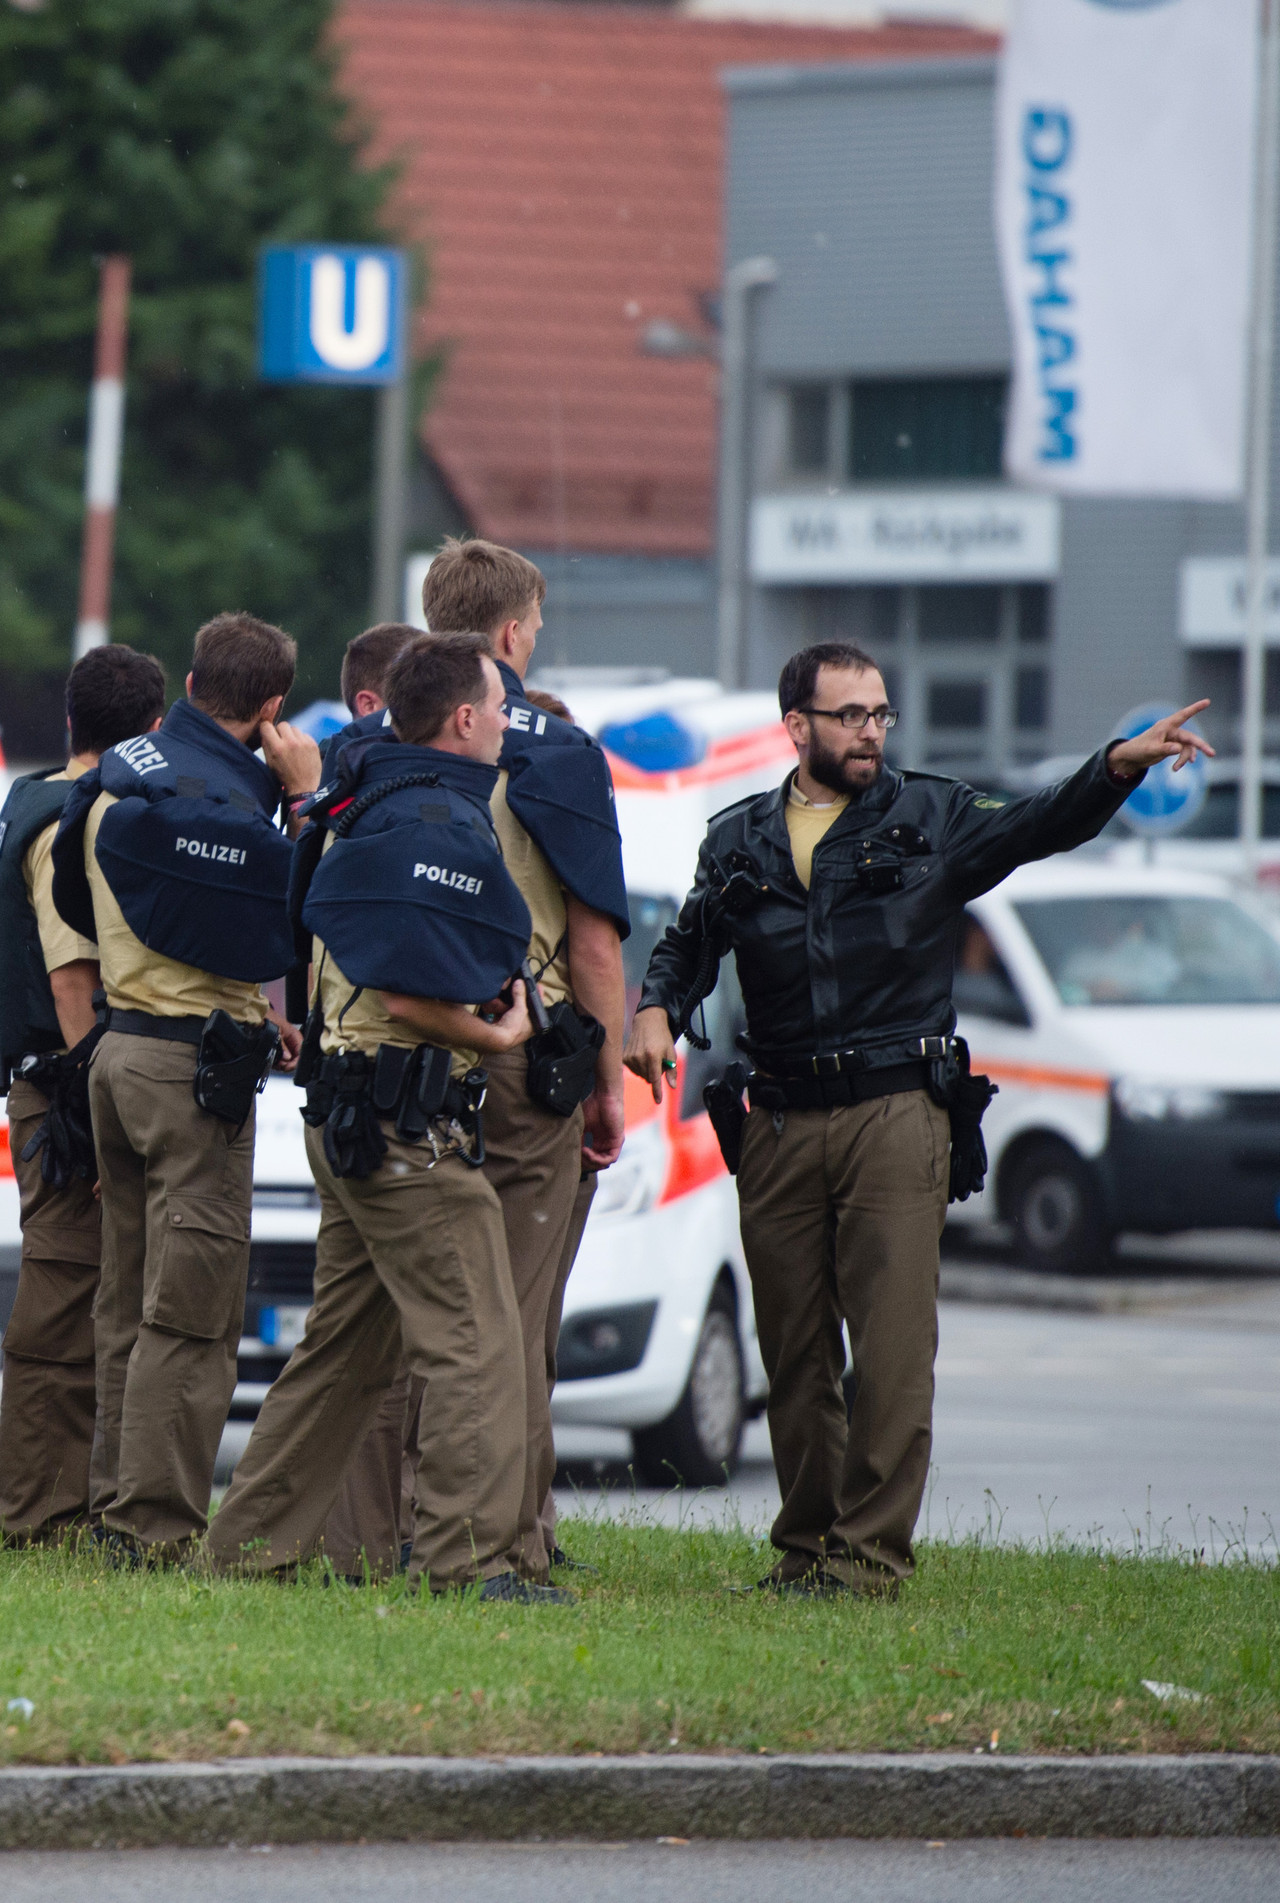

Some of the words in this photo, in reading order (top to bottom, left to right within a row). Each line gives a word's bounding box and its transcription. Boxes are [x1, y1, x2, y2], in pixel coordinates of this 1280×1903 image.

[1024, 108, 1077, 462] DAHAM
[310, 253, 389, 371] U
[113, 735, 169, 776] OLIZEI
[175, 837, 247, 865] POLIZEI
[413, 862, 483, 895] POLIZEI
